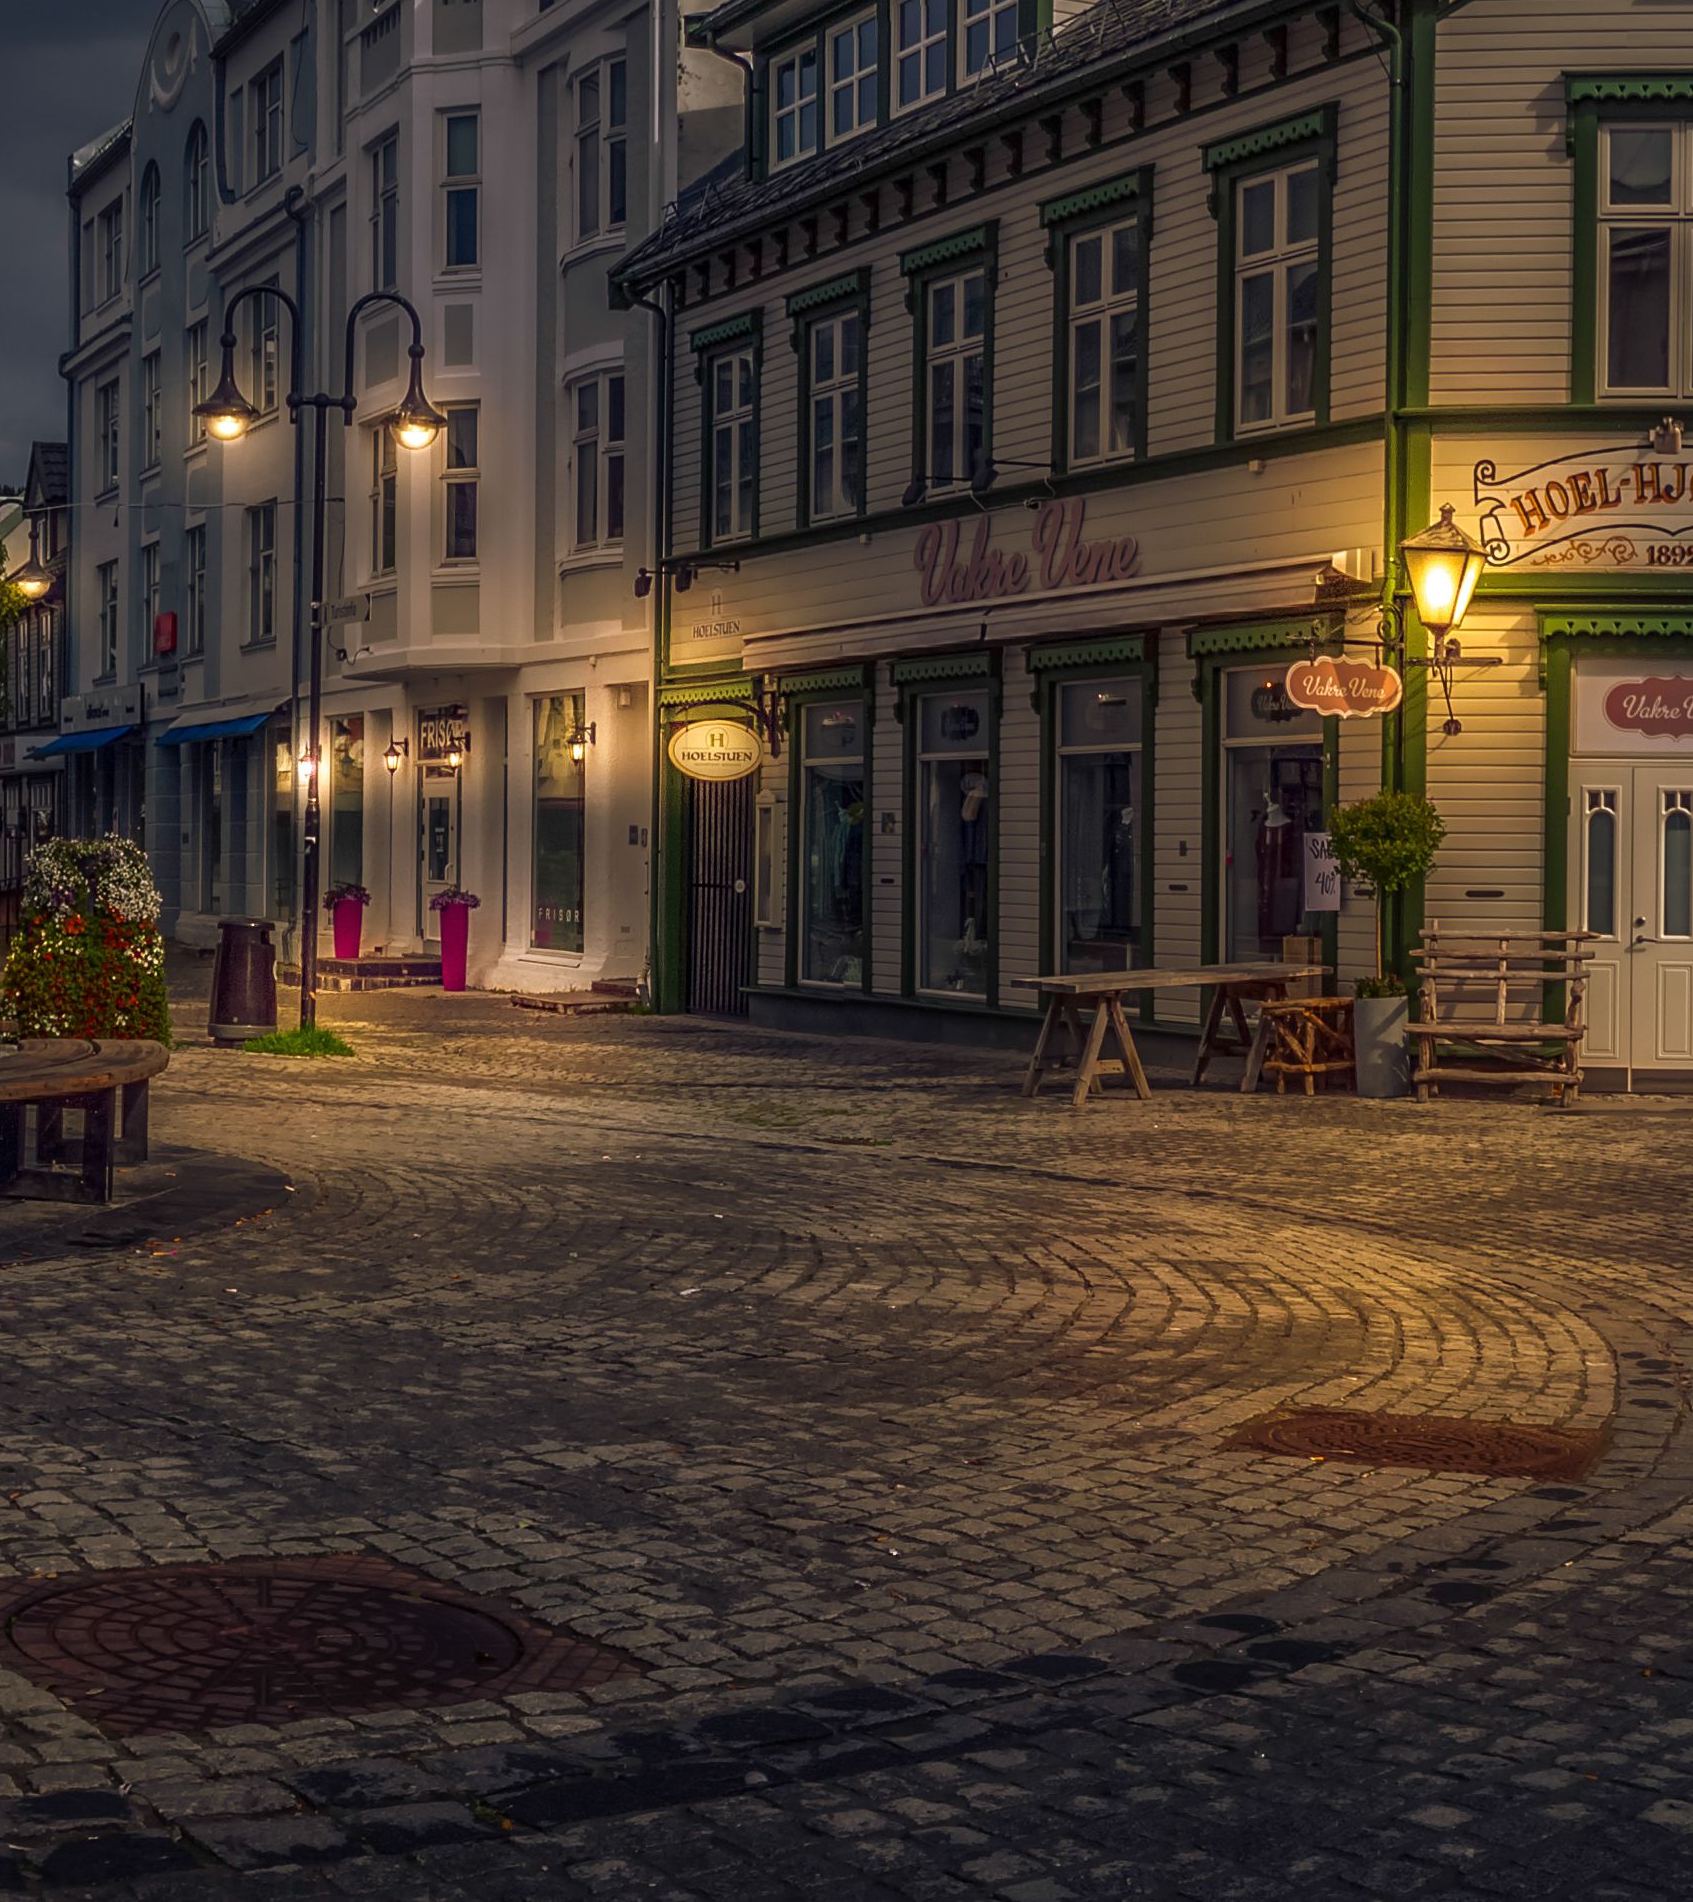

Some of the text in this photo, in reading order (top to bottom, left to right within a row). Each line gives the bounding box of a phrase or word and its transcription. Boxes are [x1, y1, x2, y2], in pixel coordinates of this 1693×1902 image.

[913, 498, 1141, 607] Vakre Vene
[693, 620, 740, 639] HOELSTUEN
[1302, 675, 1385, 699] Vakre Vene
[1622, 694, 1681, 720] Vakre
[709, 733, 725, 748] H
[681, 751, 753, 762] HOELSTUEN
